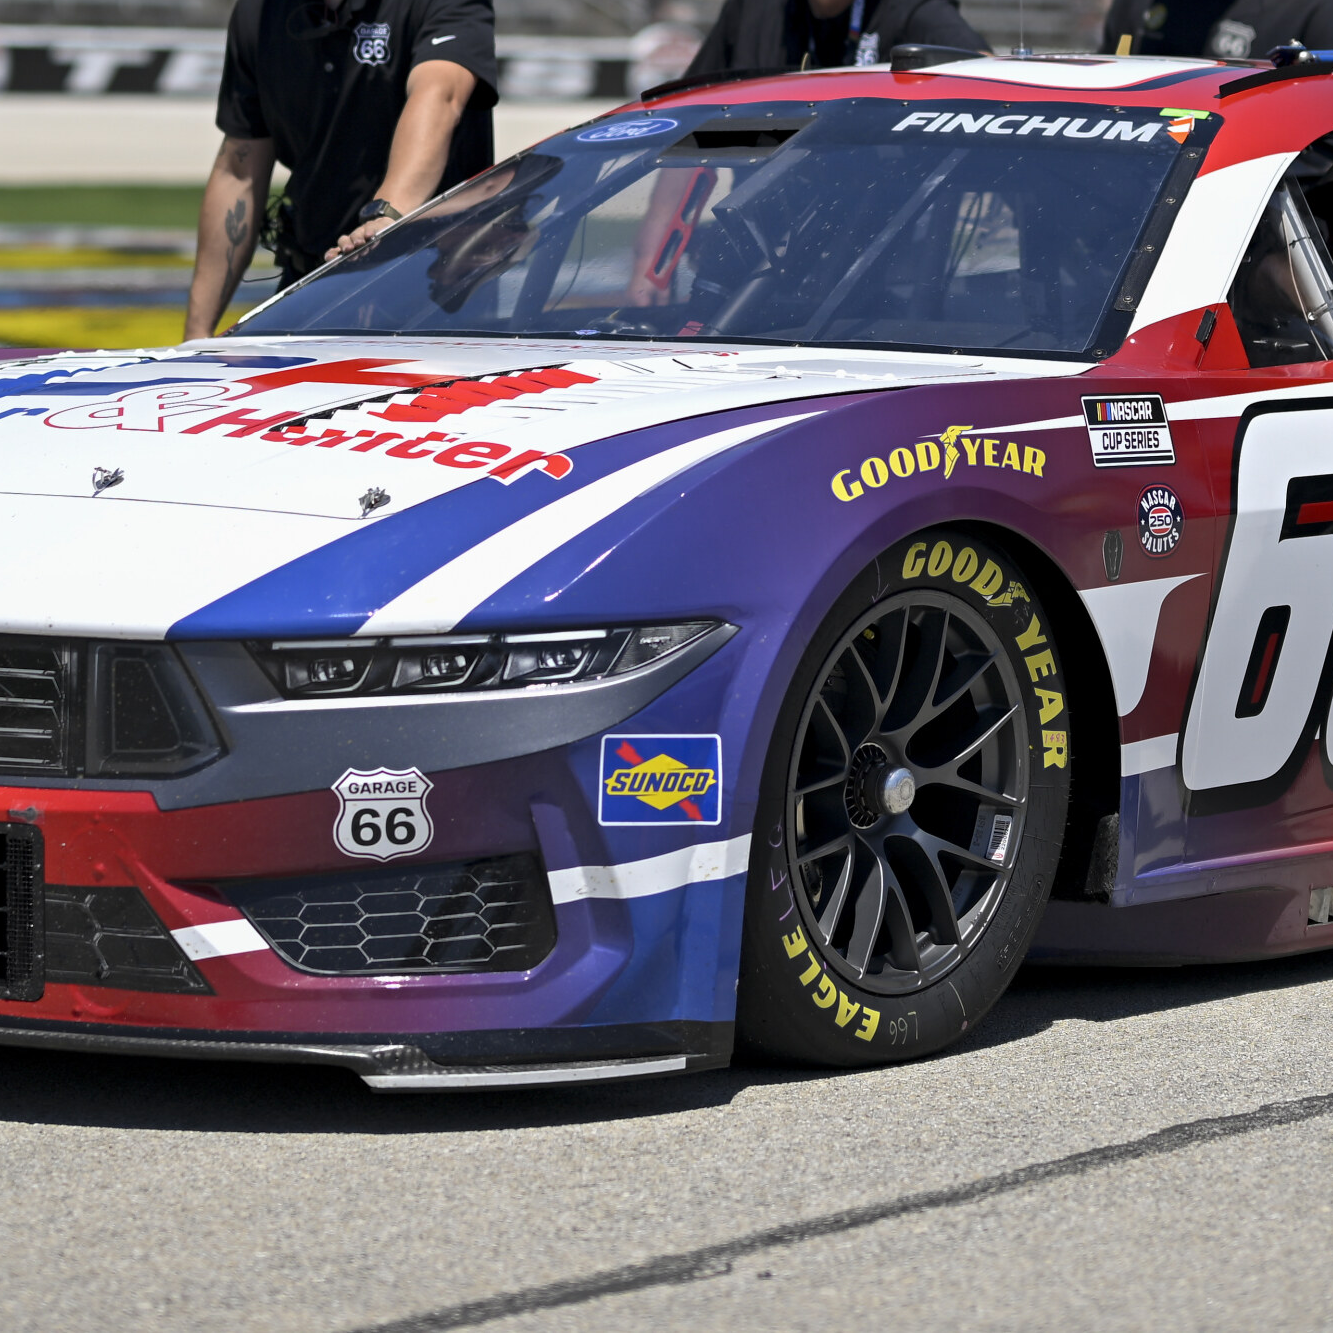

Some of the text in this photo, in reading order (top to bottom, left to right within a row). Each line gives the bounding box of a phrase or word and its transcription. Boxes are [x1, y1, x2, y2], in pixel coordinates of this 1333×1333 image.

[360, 39, 385, 59] 66
[891, 110, 1165, 144] FINCHUM
[1109, 401, 1153, 421] NASCAR
[44, 381, 253, 433] &
[179, 407, 573, 483] Hunter
[1102, 430, 1160, 451] CUP SERIES
[1140, 489, 1177, 513] NASCAR
[1149, 514, 1172, 528] 250
[1141, 527, 1180, 553] SALUTES
[348, 780, 418, 795] GARAGE
[610, 771, 711, 793] SUNOCO
[350, 806, 417, 847] 66
[781, 924, 881, 1042] EAGLE
